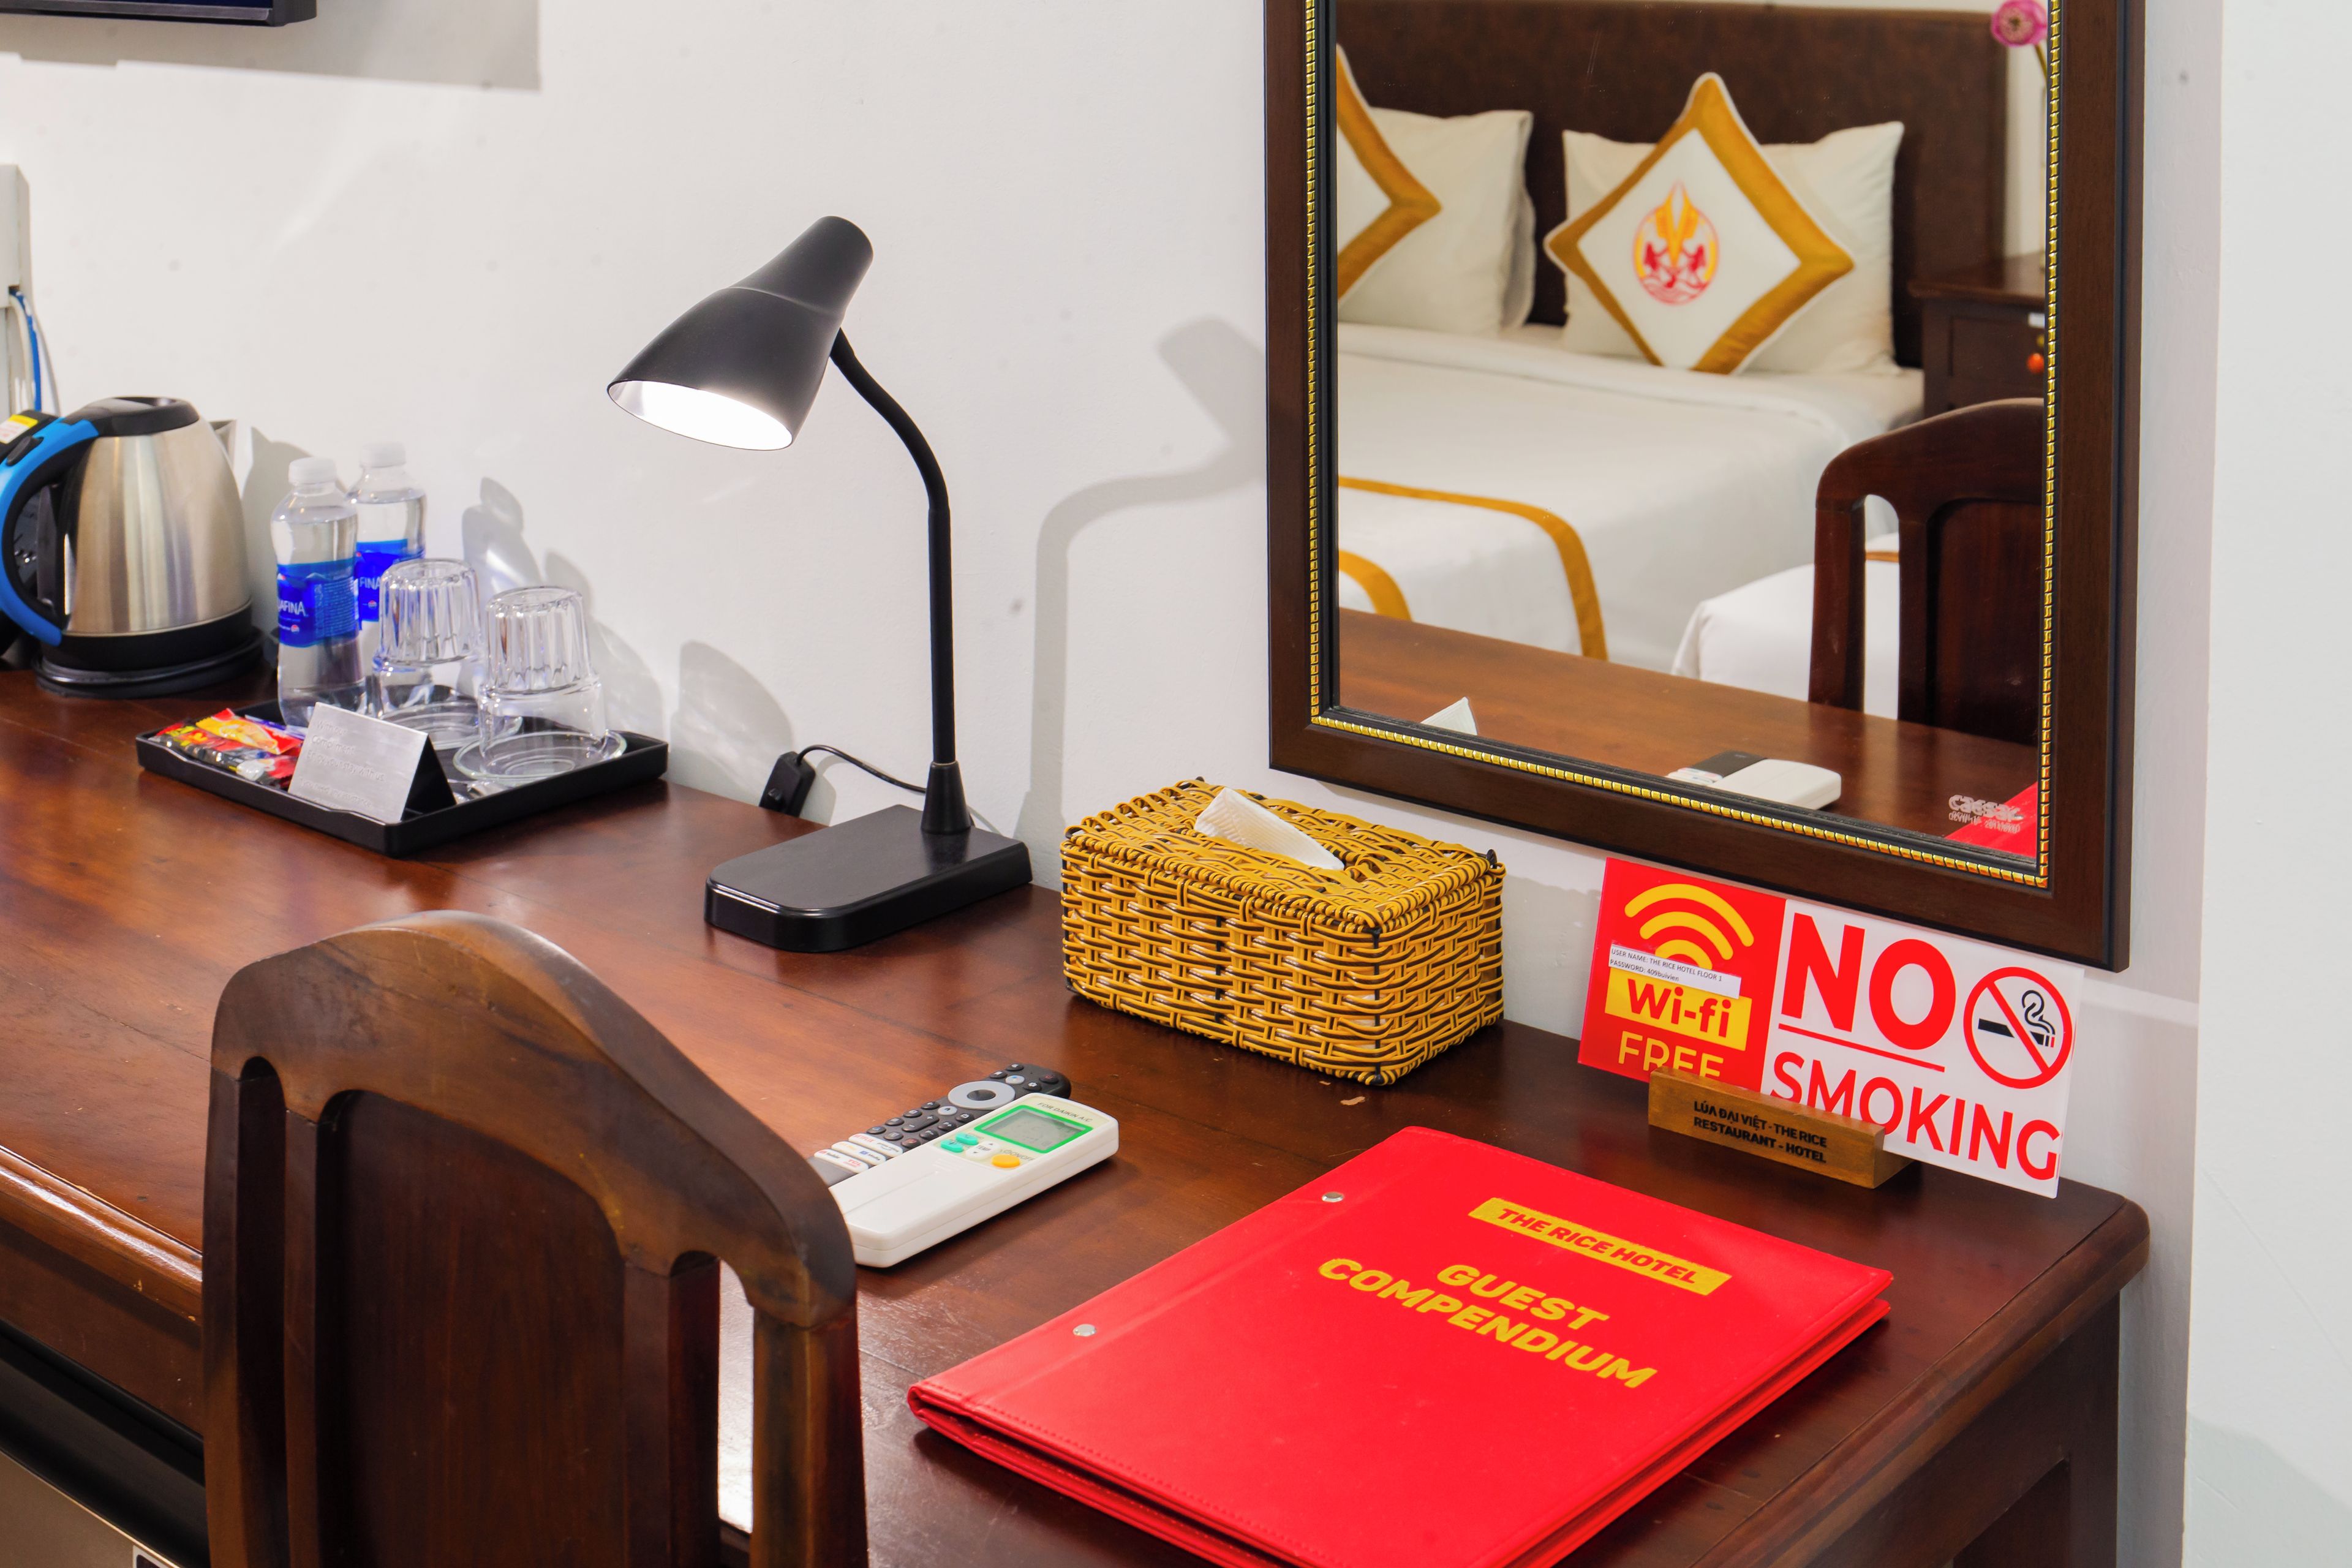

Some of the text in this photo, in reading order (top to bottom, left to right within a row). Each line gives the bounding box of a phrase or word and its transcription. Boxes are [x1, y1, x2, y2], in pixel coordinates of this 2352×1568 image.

[1610, 959, 1679, 982] PASSWORD: 409buivien
[1611, 948, 1627, 957] USER
[1627, 952, 1648, 963] NAME:
[1650, 957, 1661, 967] THE
[1662, 961, 1675, 970] RICE
[1677, 965, 1696, 975] HOTEL
[1697, 970, 1717, 981] FLOOR
[1781, 912, 1956, 1050] NO
[1627, 978, 1732, 1038] Wi-fi
[1618, 1030, 1724, 1077] FREE
[1694, 1117, 1776, 1148] RESTAURANT
[1785, 1143, 1826, 1163] HOTEL
[1741, 1115, 1768, 1131] VIỆT
[1774, 1123, 1798, 1139] THE
[1800, 1129, 1827, 1148] RICE
[1770, 1051, 2061, 1180] SMOKING
[1497, 1208, 1698, 1284] THE RICE HOTEL
[1318, 1259, 1657, 1388] COMPENDIUM
[1437, 1264, 1610, 1330] GUEST
